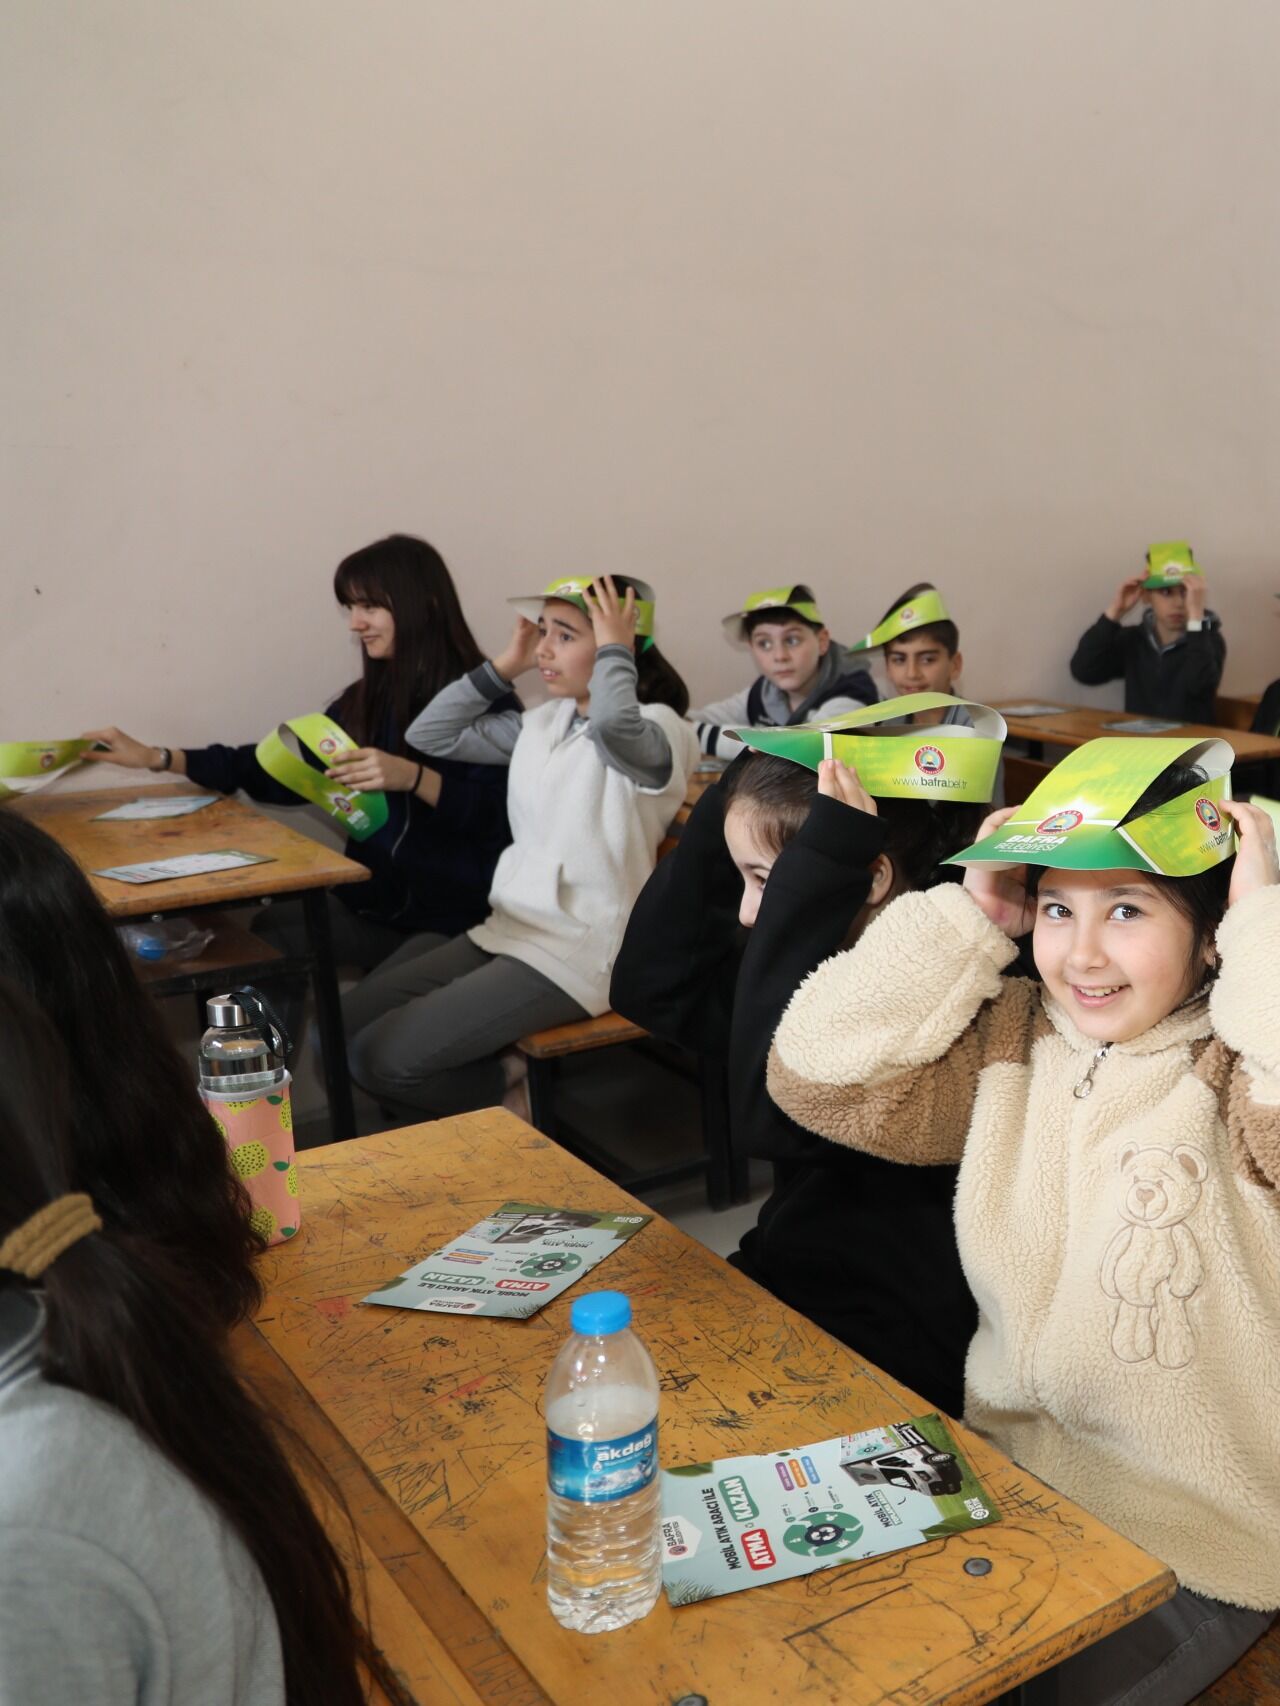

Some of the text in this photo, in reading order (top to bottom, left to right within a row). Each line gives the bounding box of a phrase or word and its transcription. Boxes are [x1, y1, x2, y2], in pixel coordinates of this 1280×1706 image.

[1005, 835, 1068, 845] BAFRA
[424, 1272, 481, 1285] KAZAN
[499, 1280, 546, 1291] ATMA
[468, 1287, 492, 1295] ATIK
[723, 1478, 754, 1520] KAZAN
[864, 1493, 880, 1508] ATIK
[874, 1508, 892, 1528] MOBİL
[662, 1522, 677, 1547] BAFRA
[702, 1487, 742, 1570] MOBİL ATIK ARACI İLE
[744, 1531, 775, 1568] ATMA
